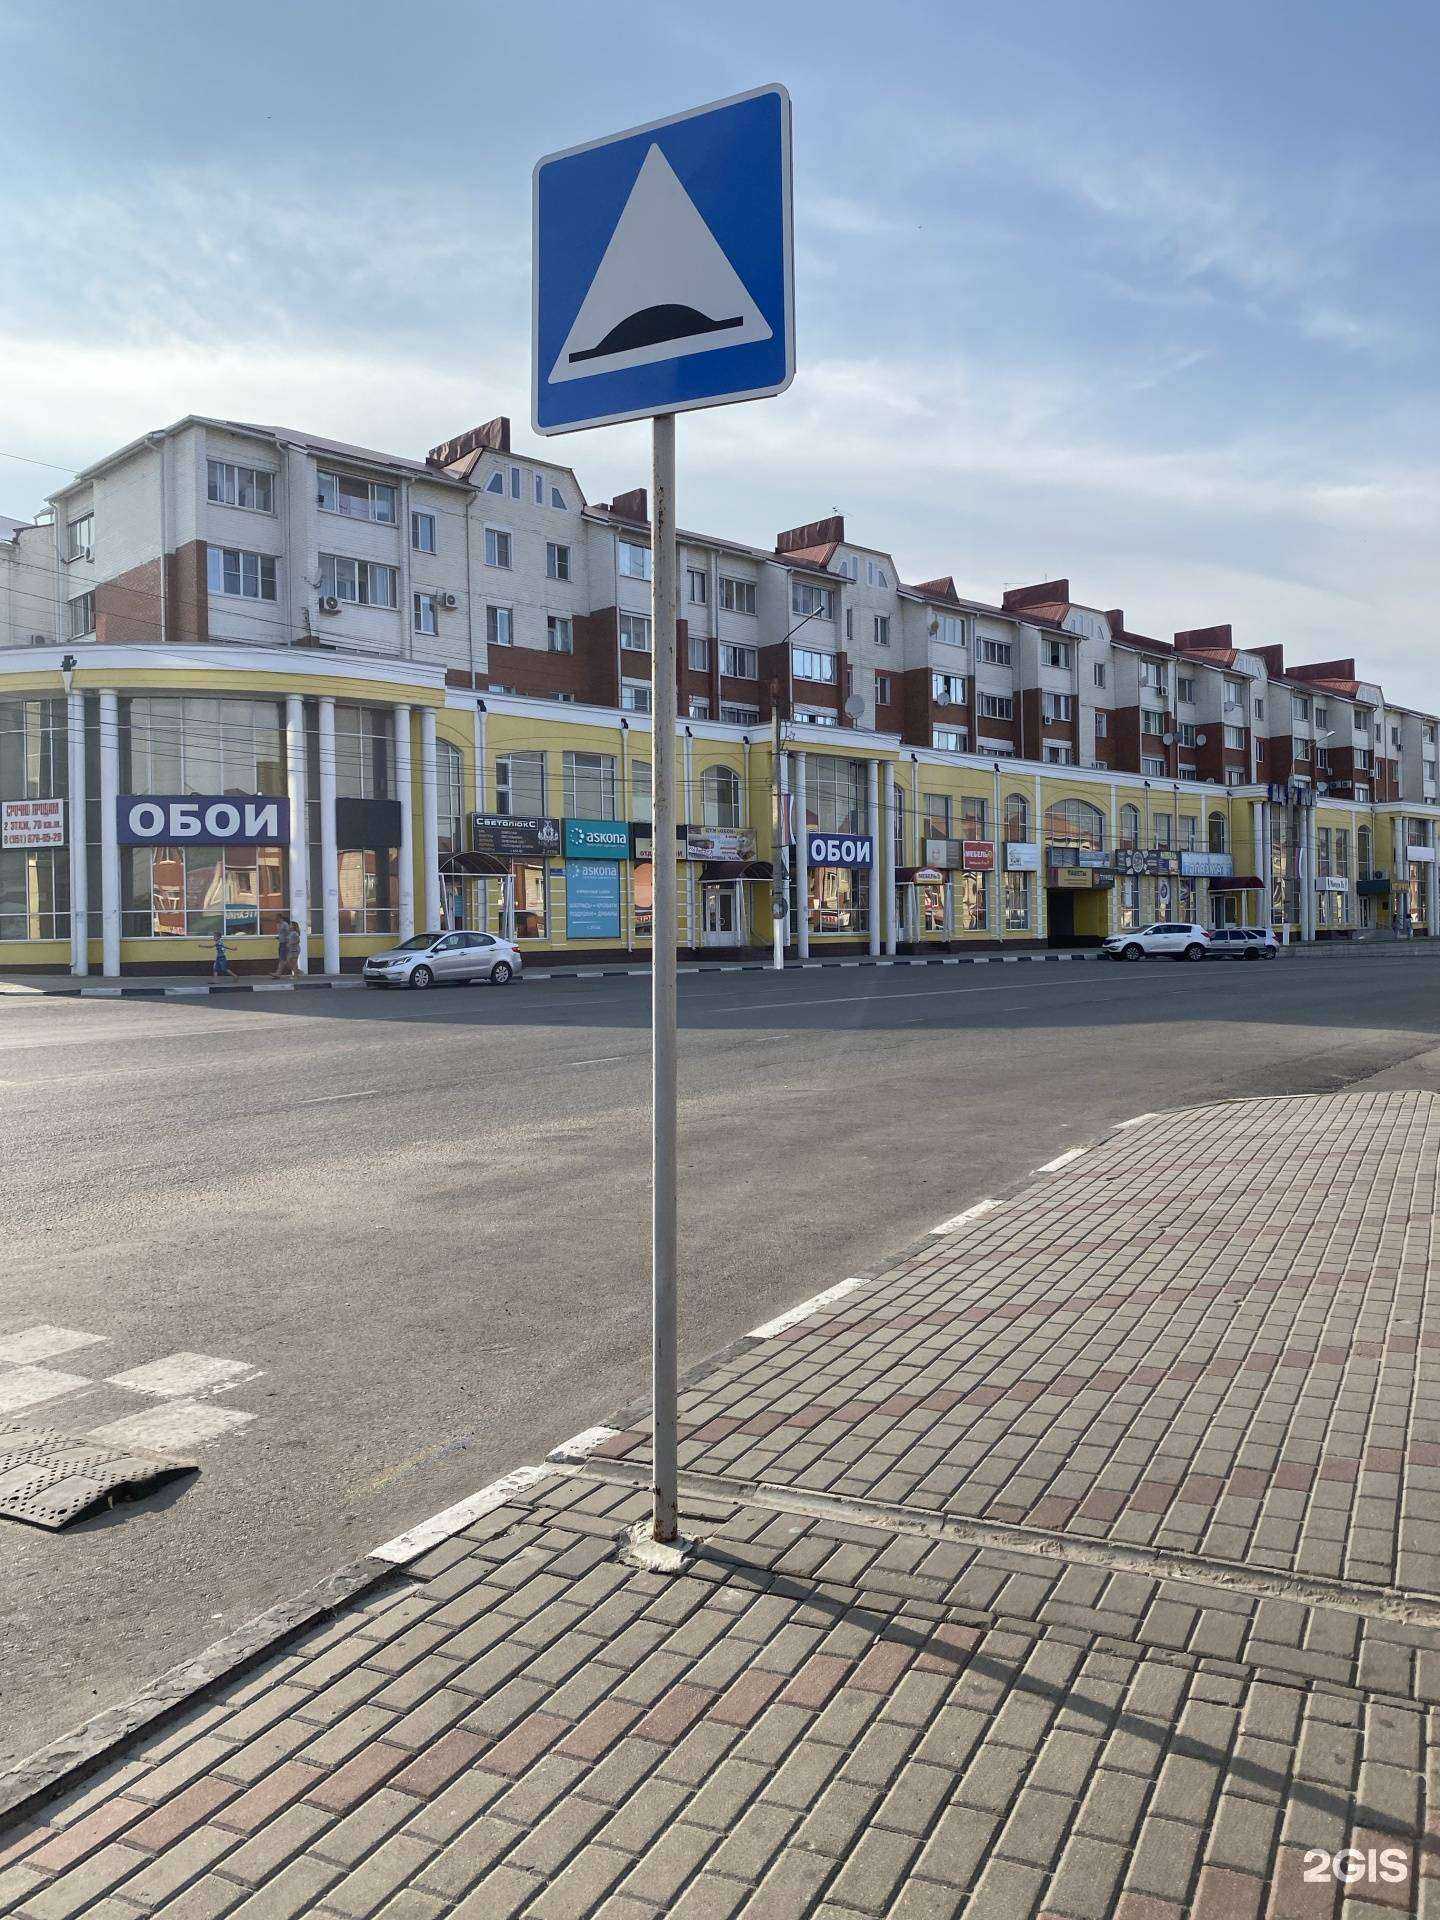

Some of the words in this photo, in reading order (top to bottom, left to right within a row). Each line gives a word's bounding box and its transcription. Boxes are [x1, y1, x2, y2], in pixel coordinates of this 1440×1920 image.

[129, 803, 278, 837] ОБОИ
[586, 832, 627, 844] askona
[810, 839, 871, 863] ОБОИ
[582, 866, 617, 876] askona
